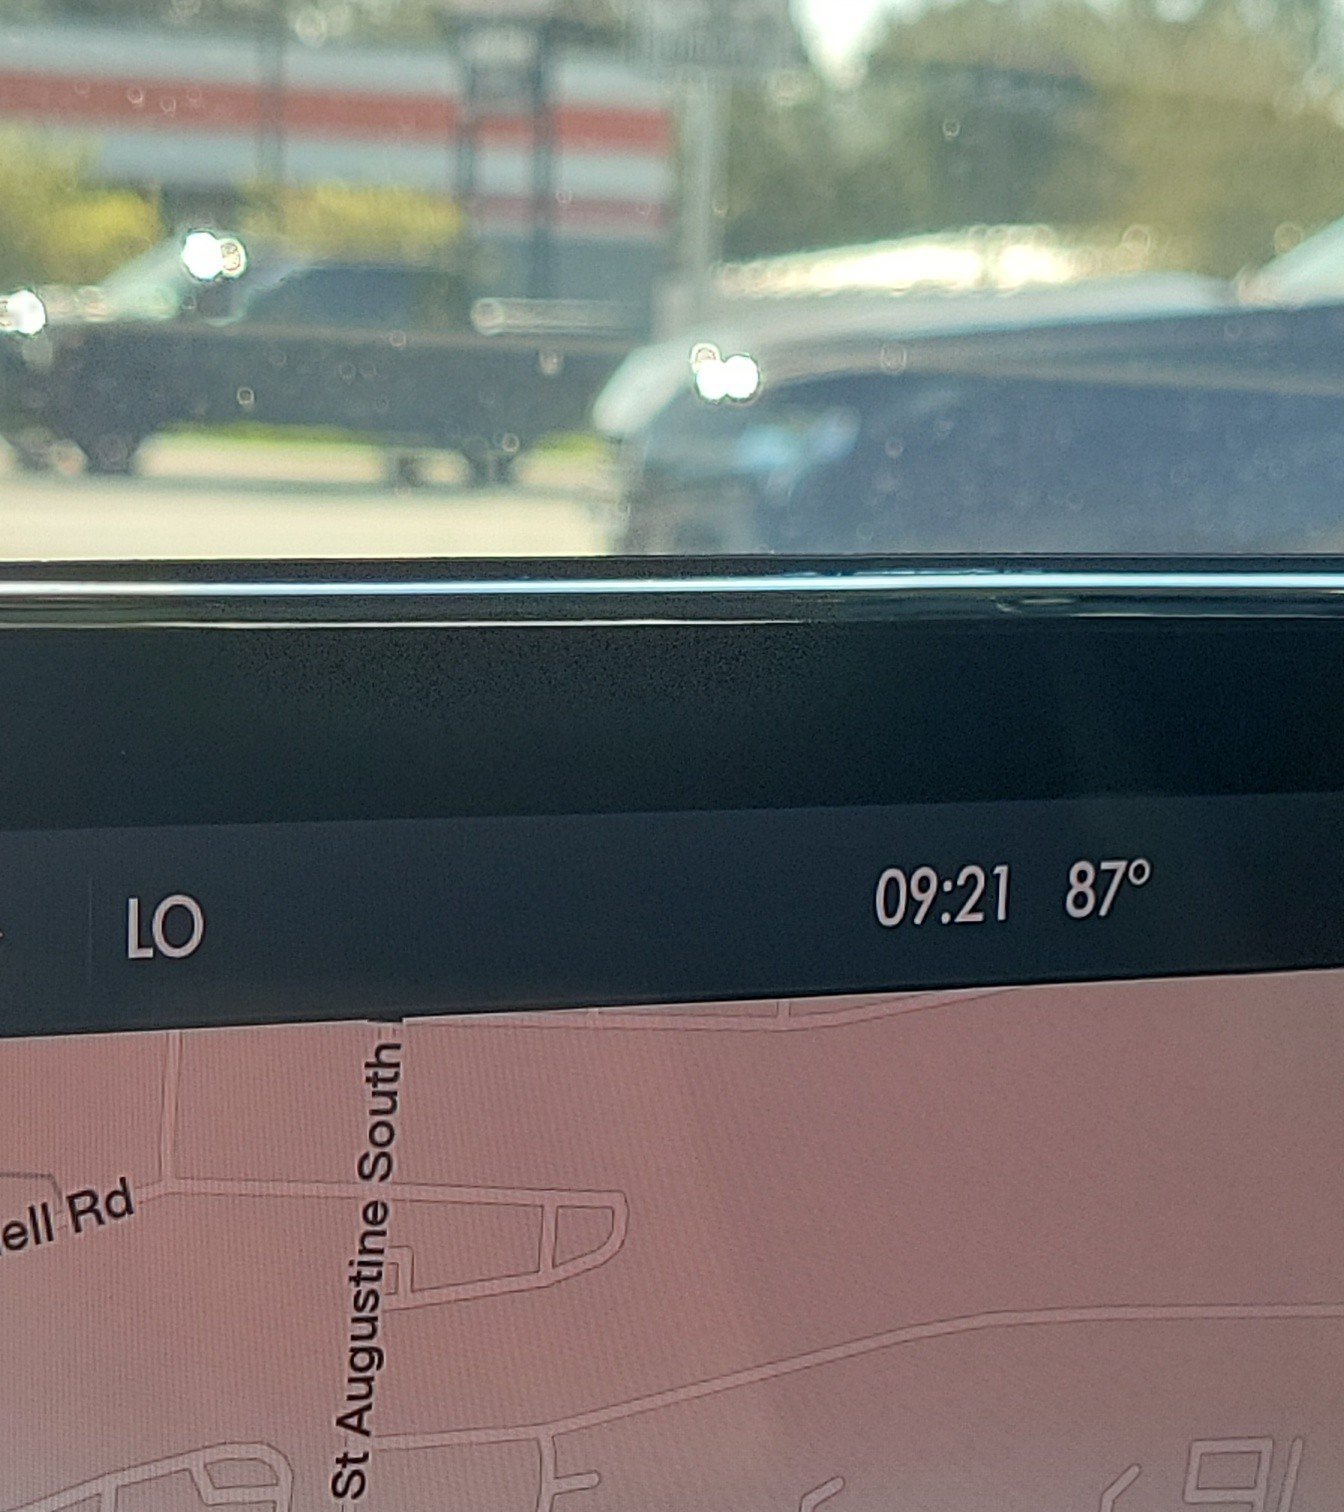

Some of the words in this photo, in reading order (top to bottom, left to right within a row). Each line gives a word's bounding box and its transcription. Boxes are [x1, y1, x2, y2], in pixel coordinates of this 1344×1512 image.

[126, 894, 205, 960] LO
[874, 862, 1012, 927] 09:21
[357, 1041, 403, 1183] South
[66, 1176, 136, 1234] Rd
[335, 1200, 389, 1438] Augustine
[331, 1450, 370, 1501] St
